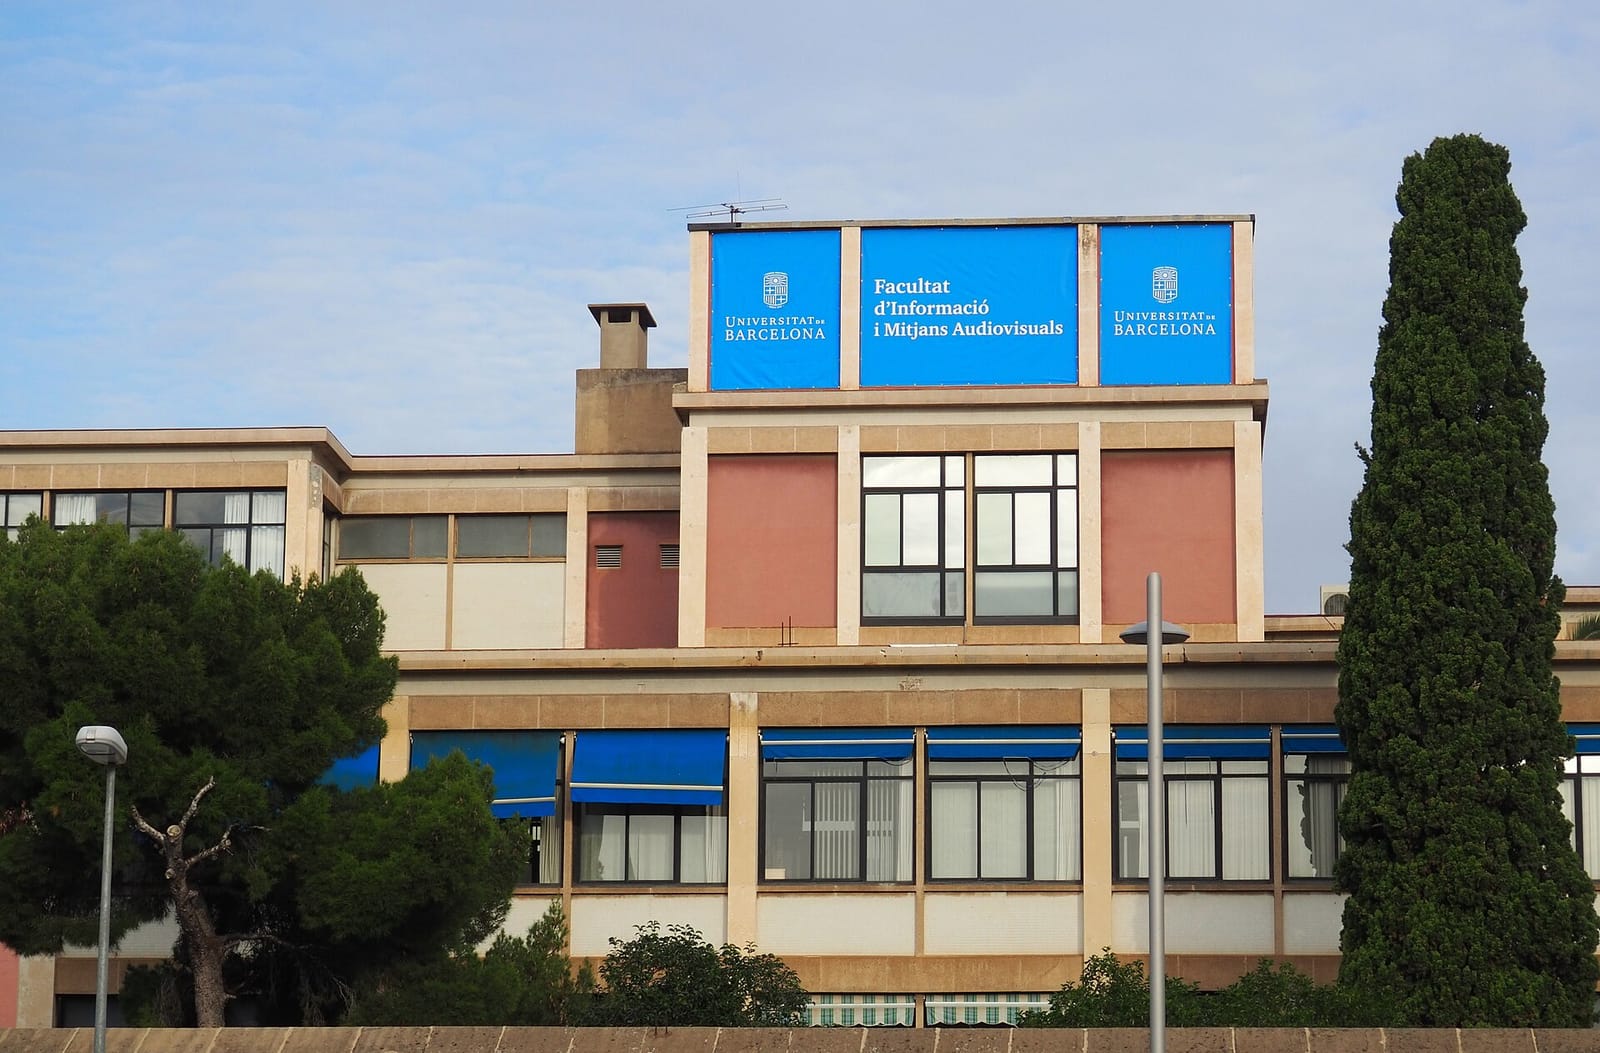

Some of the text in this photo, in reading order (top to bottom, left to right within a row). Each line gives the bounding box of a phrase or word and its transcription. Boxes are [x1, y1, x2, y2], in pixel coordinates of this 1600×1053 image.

[874, 277, 950, 294] Facultat
[874, 299, 989, 316] d'Informació
[725, 316, 815, 327] UNIVERSITAT
[1114, 311, 1205, 322] UNIVERSITAT
[725, 328, 826, 341] BARCELONA
[874, 320, 1064, 340] i Mitjans Audiovisuals
[1114, 323, 1217, 336] BARCELONA
